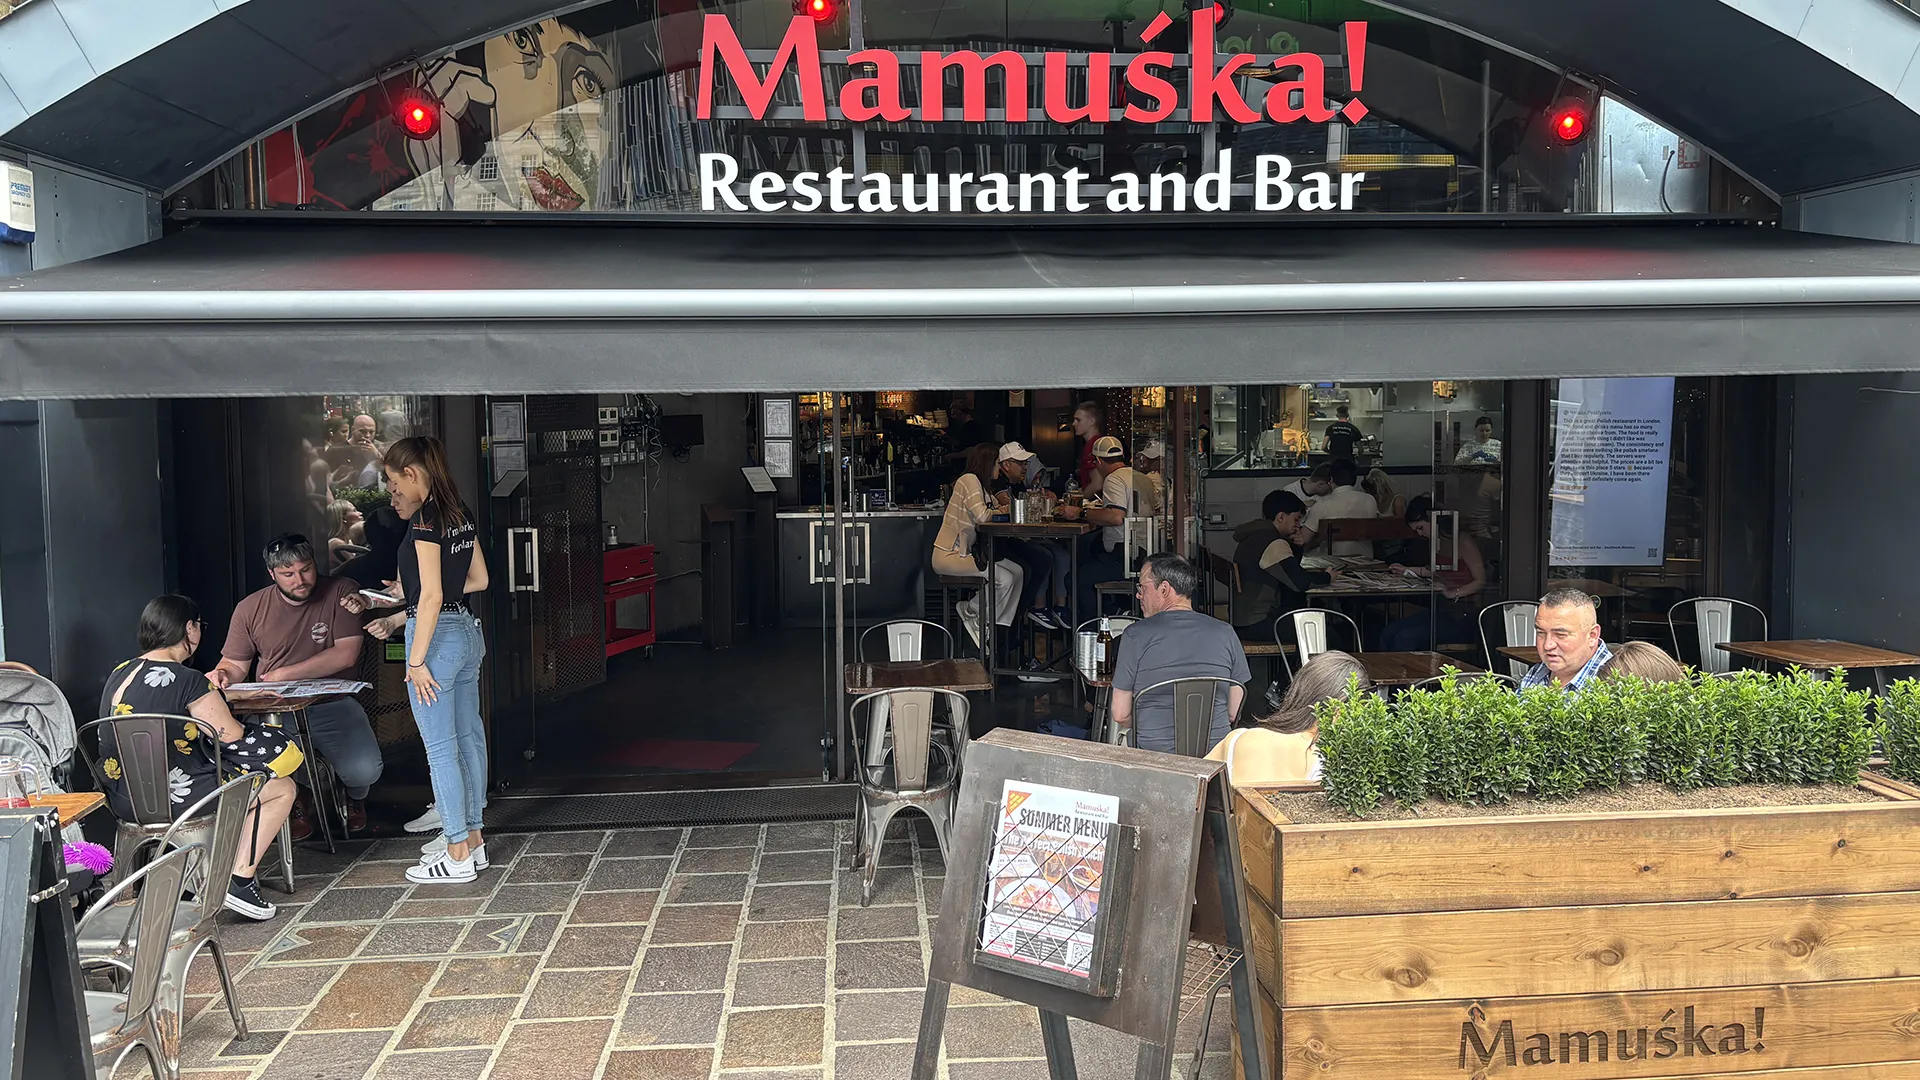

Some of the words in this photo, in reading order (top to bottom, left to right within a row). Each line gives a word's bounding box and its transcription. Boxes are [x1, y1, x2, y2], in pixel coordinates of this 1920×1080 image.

[697, 8, 1370, 127] Mamuśka!
[699, 152, 1093, 214] Restaurant
[1106, 149, 1232, 212] and
[1254, 154, 1365, 212] Bar
[1020, 808, 1071, 833] SUMMER
[1073, 818, 1109, 839] MENU
[1052, 842, 1077, 856] Plish
[1459, 1005, 1766, 1070] Mamuśka!
